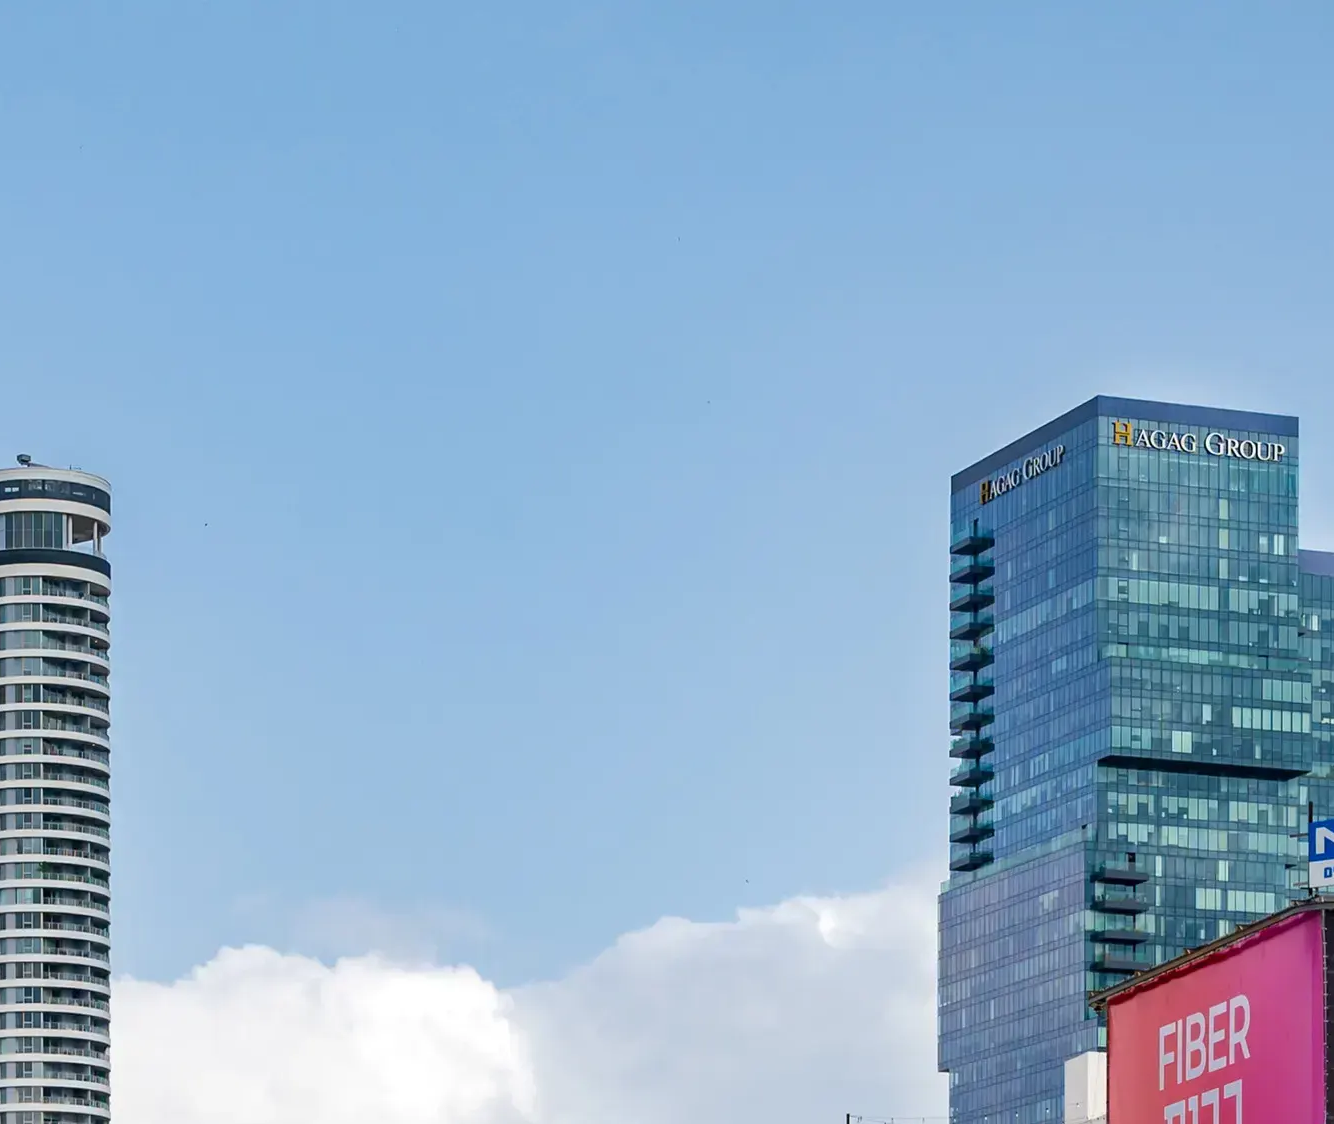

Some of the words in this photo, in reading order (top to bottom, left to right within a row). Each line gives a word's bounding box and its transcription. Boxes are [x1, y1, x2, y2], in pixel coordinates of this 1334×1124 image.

[1112, 420, 1196, 453] HAGAG
[1205, 431, 1285, 462] GROUP
[980, 467, 1020, 505] HAGAG
[1022, 444, 1065, 480] GROUP
[1158, 994, 1251, 1091] FIBER
